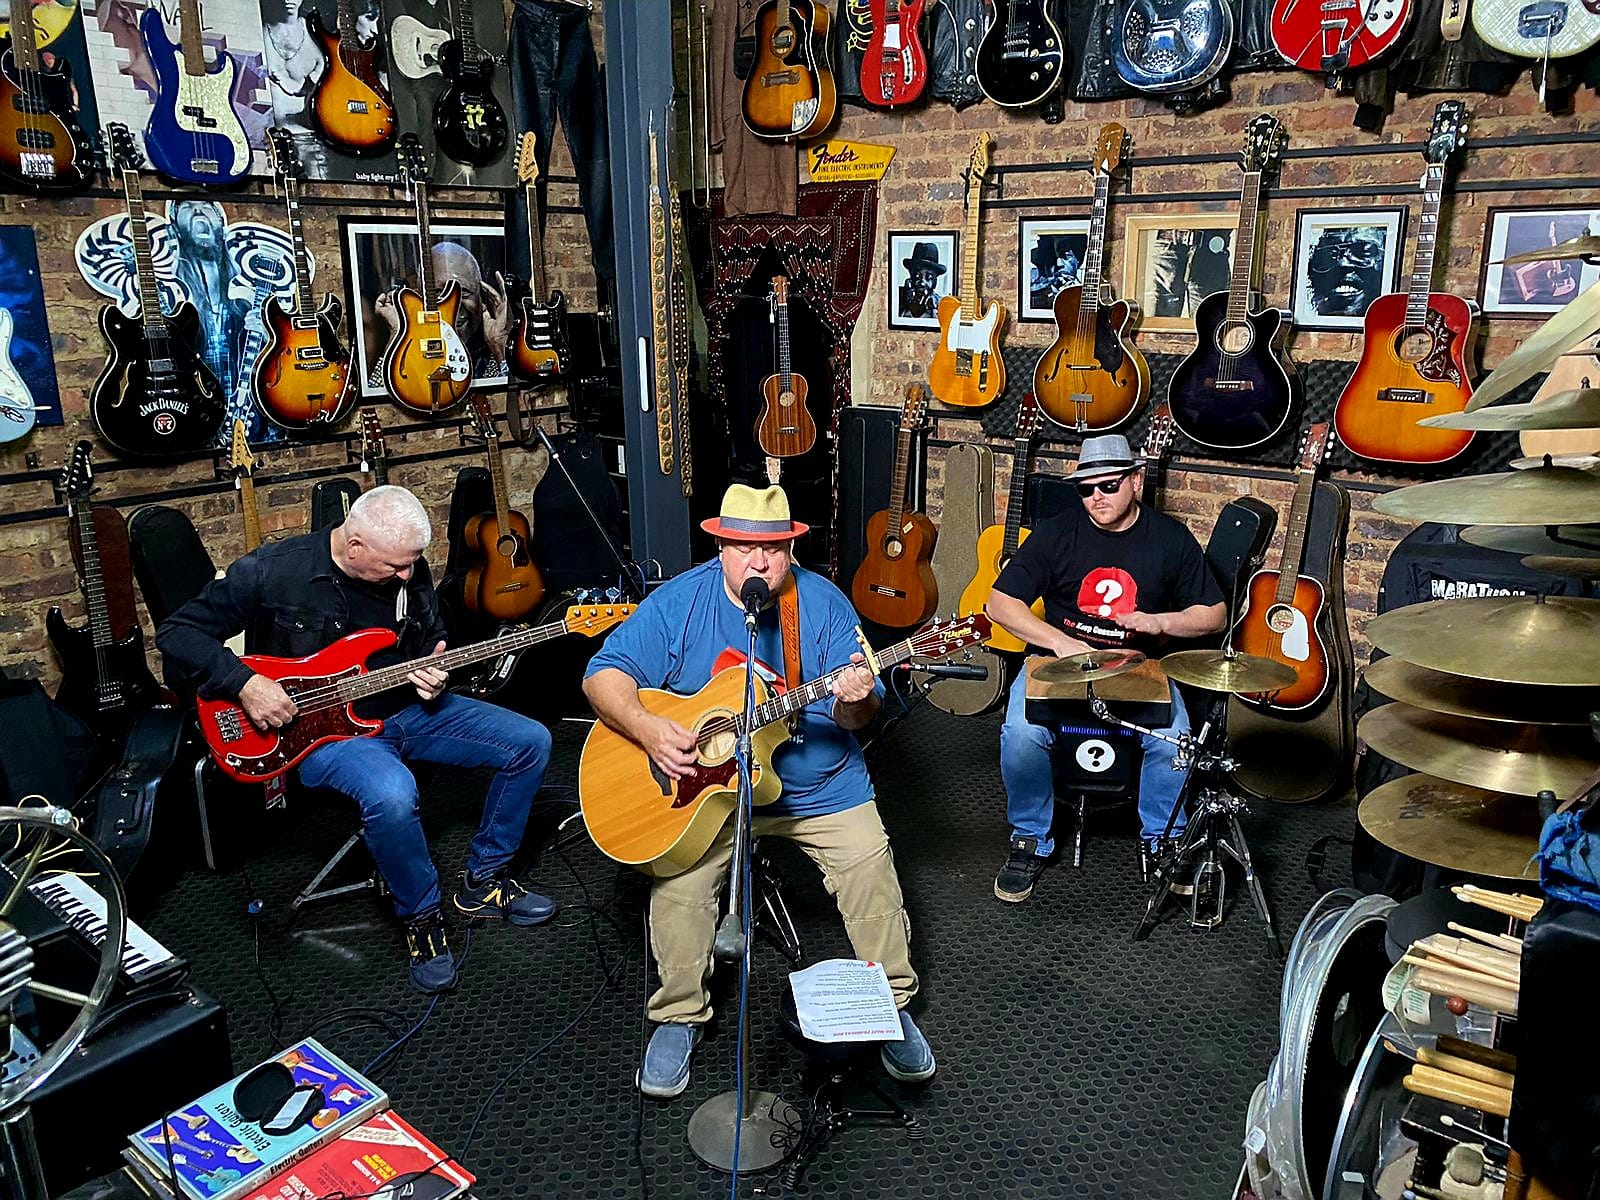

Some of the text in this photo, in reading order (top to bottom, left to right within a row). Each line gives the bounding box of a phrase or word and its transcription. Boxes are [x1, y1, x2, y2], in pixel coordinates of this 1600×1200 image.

[812, 143, 860, 174] Fender
[830, 164, 852, 172] ELECTRIC
[853, 161, 885, 171] INSTRUMENTS
[355, 172, 370, 182] baby
[371, 172, 385, 182] light
[1063, 618, 1076, 628] The
[1076, 622, 1093, 633] Keep
[1092, 626, 1125, 640] Guessing
[214, 1102, 272, 1152] Electric Guitars
[270, 1137, 325, 1176] Electric Guitars
